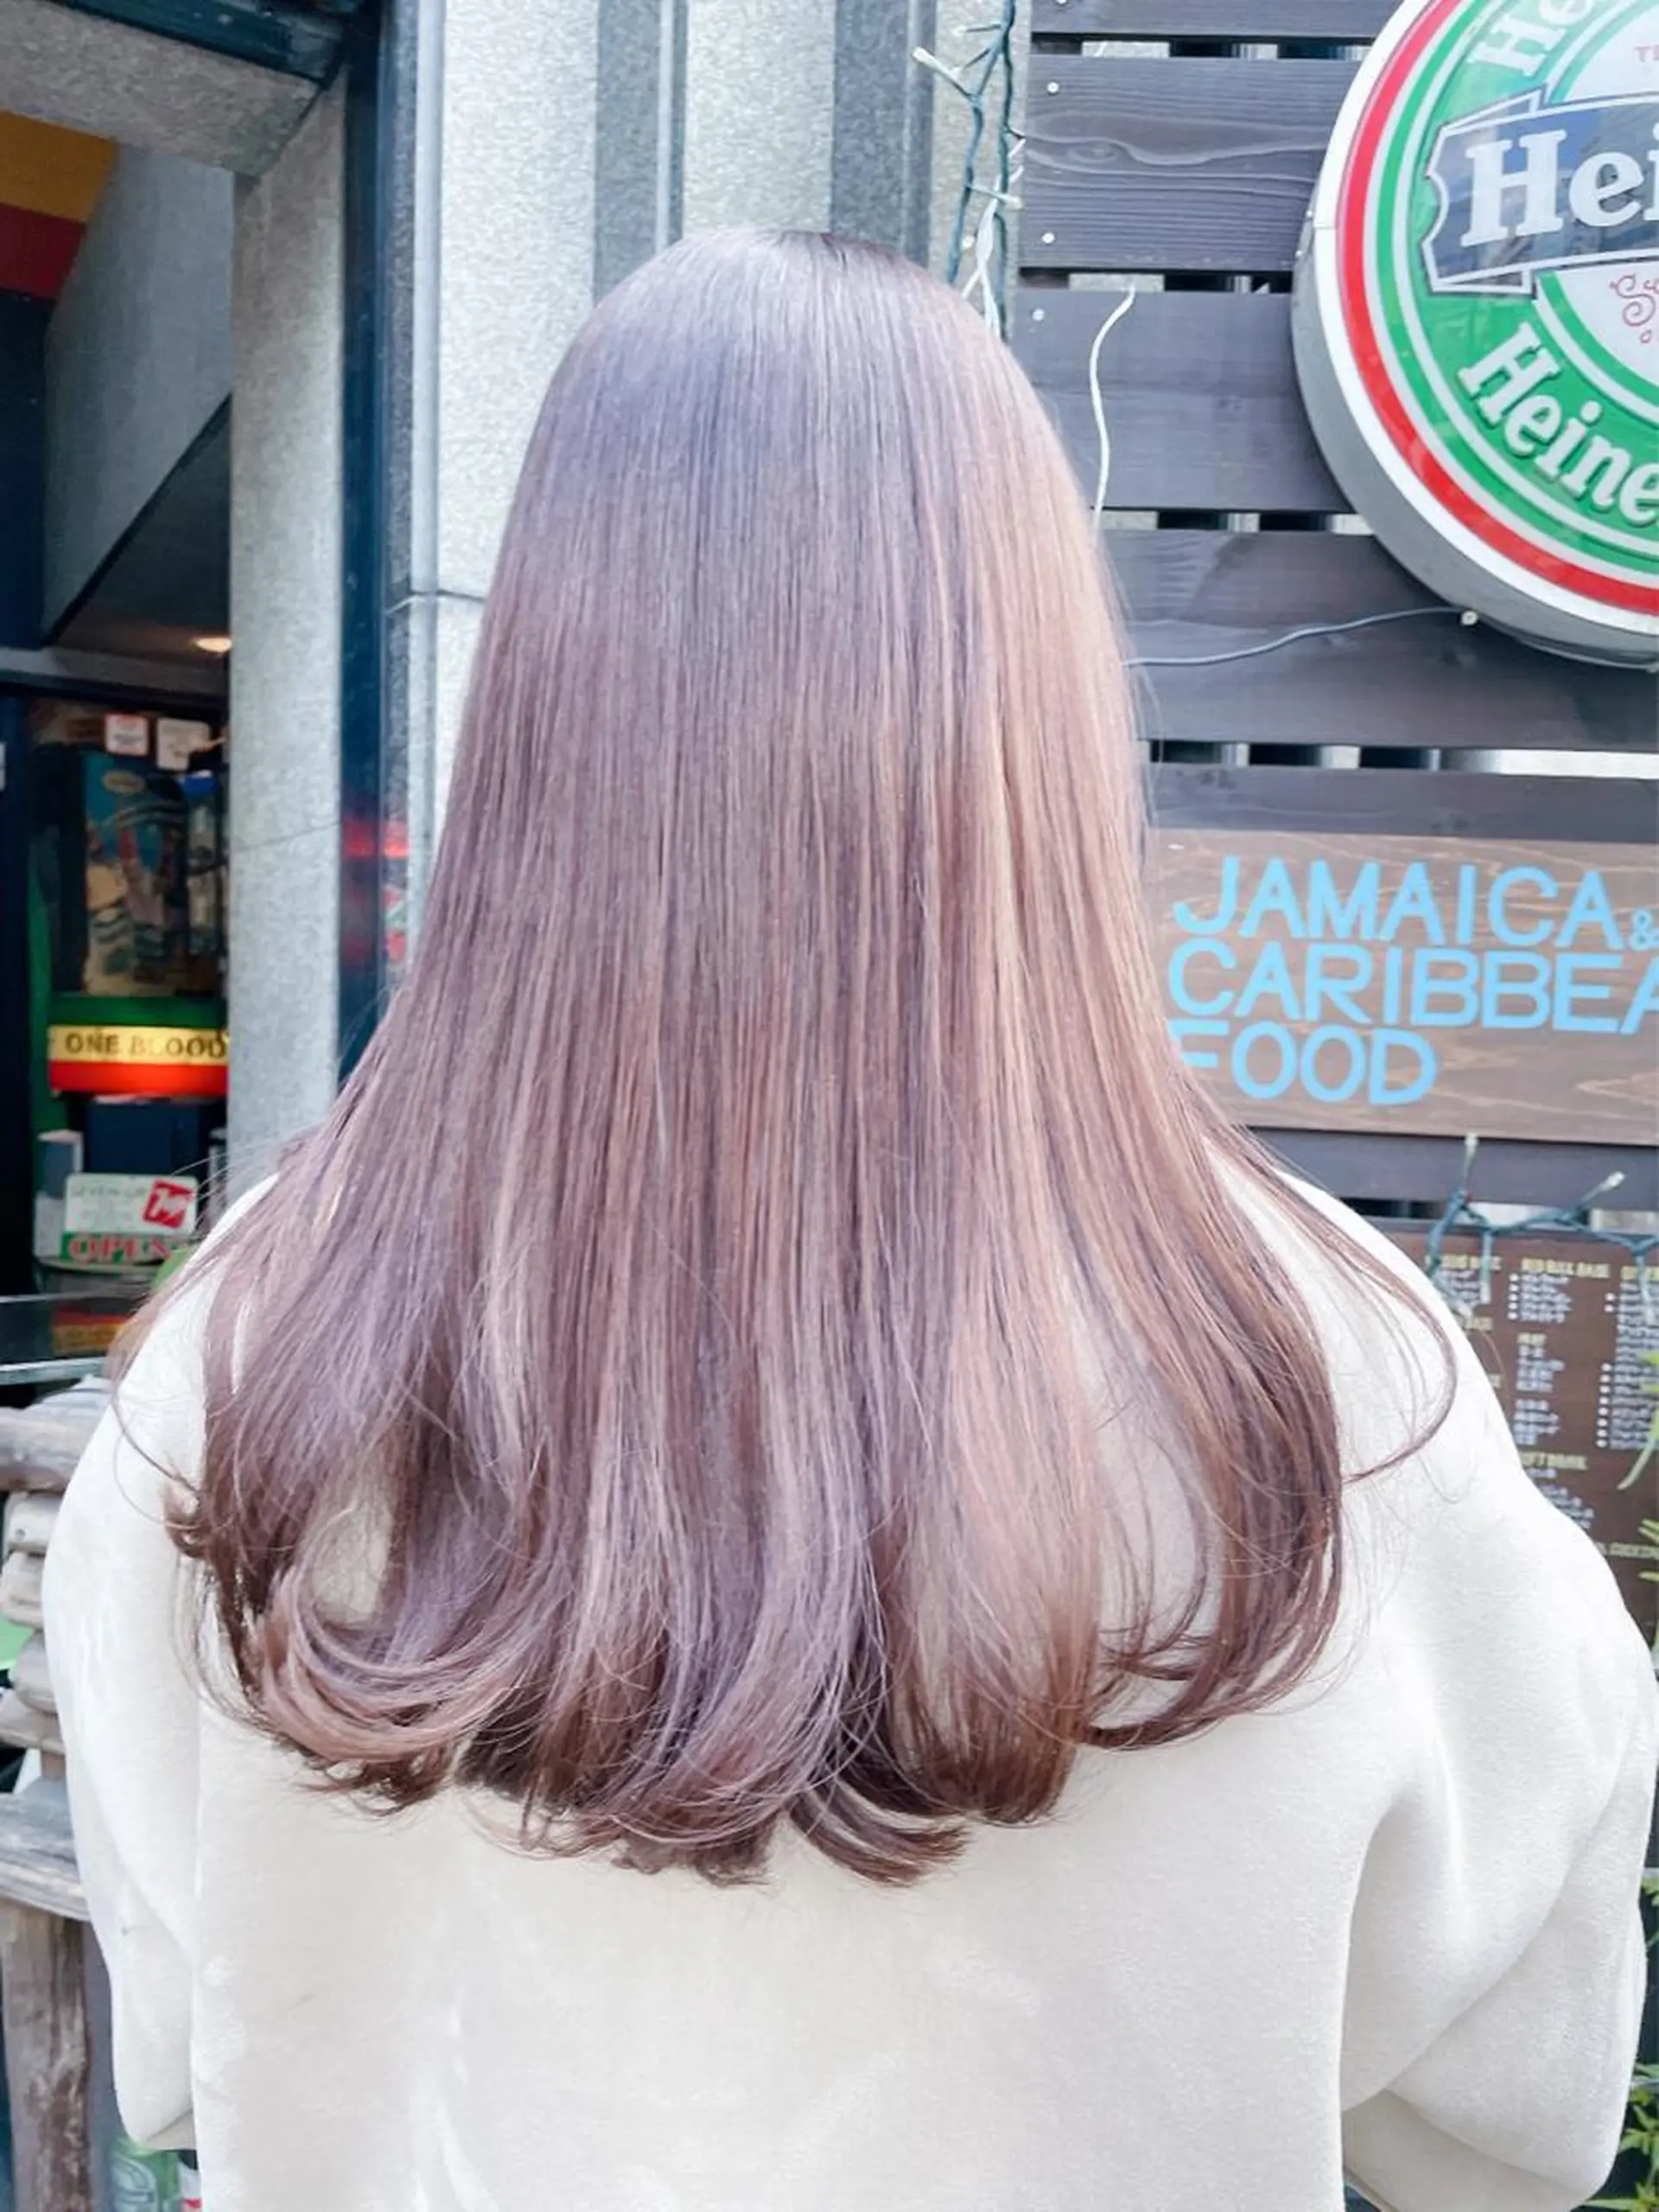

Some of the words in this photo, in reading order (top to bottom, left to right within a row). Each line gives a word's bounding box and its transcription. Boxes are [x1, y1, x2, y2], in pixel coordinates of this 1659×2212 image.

[1174, 855, 1623, 950] JAMAICA
[66, 1032, 119, 1054] ONE
[130, 1035, 226, 1059] BLOOD
[1166, 1020, 1436, 1105] FOOD
